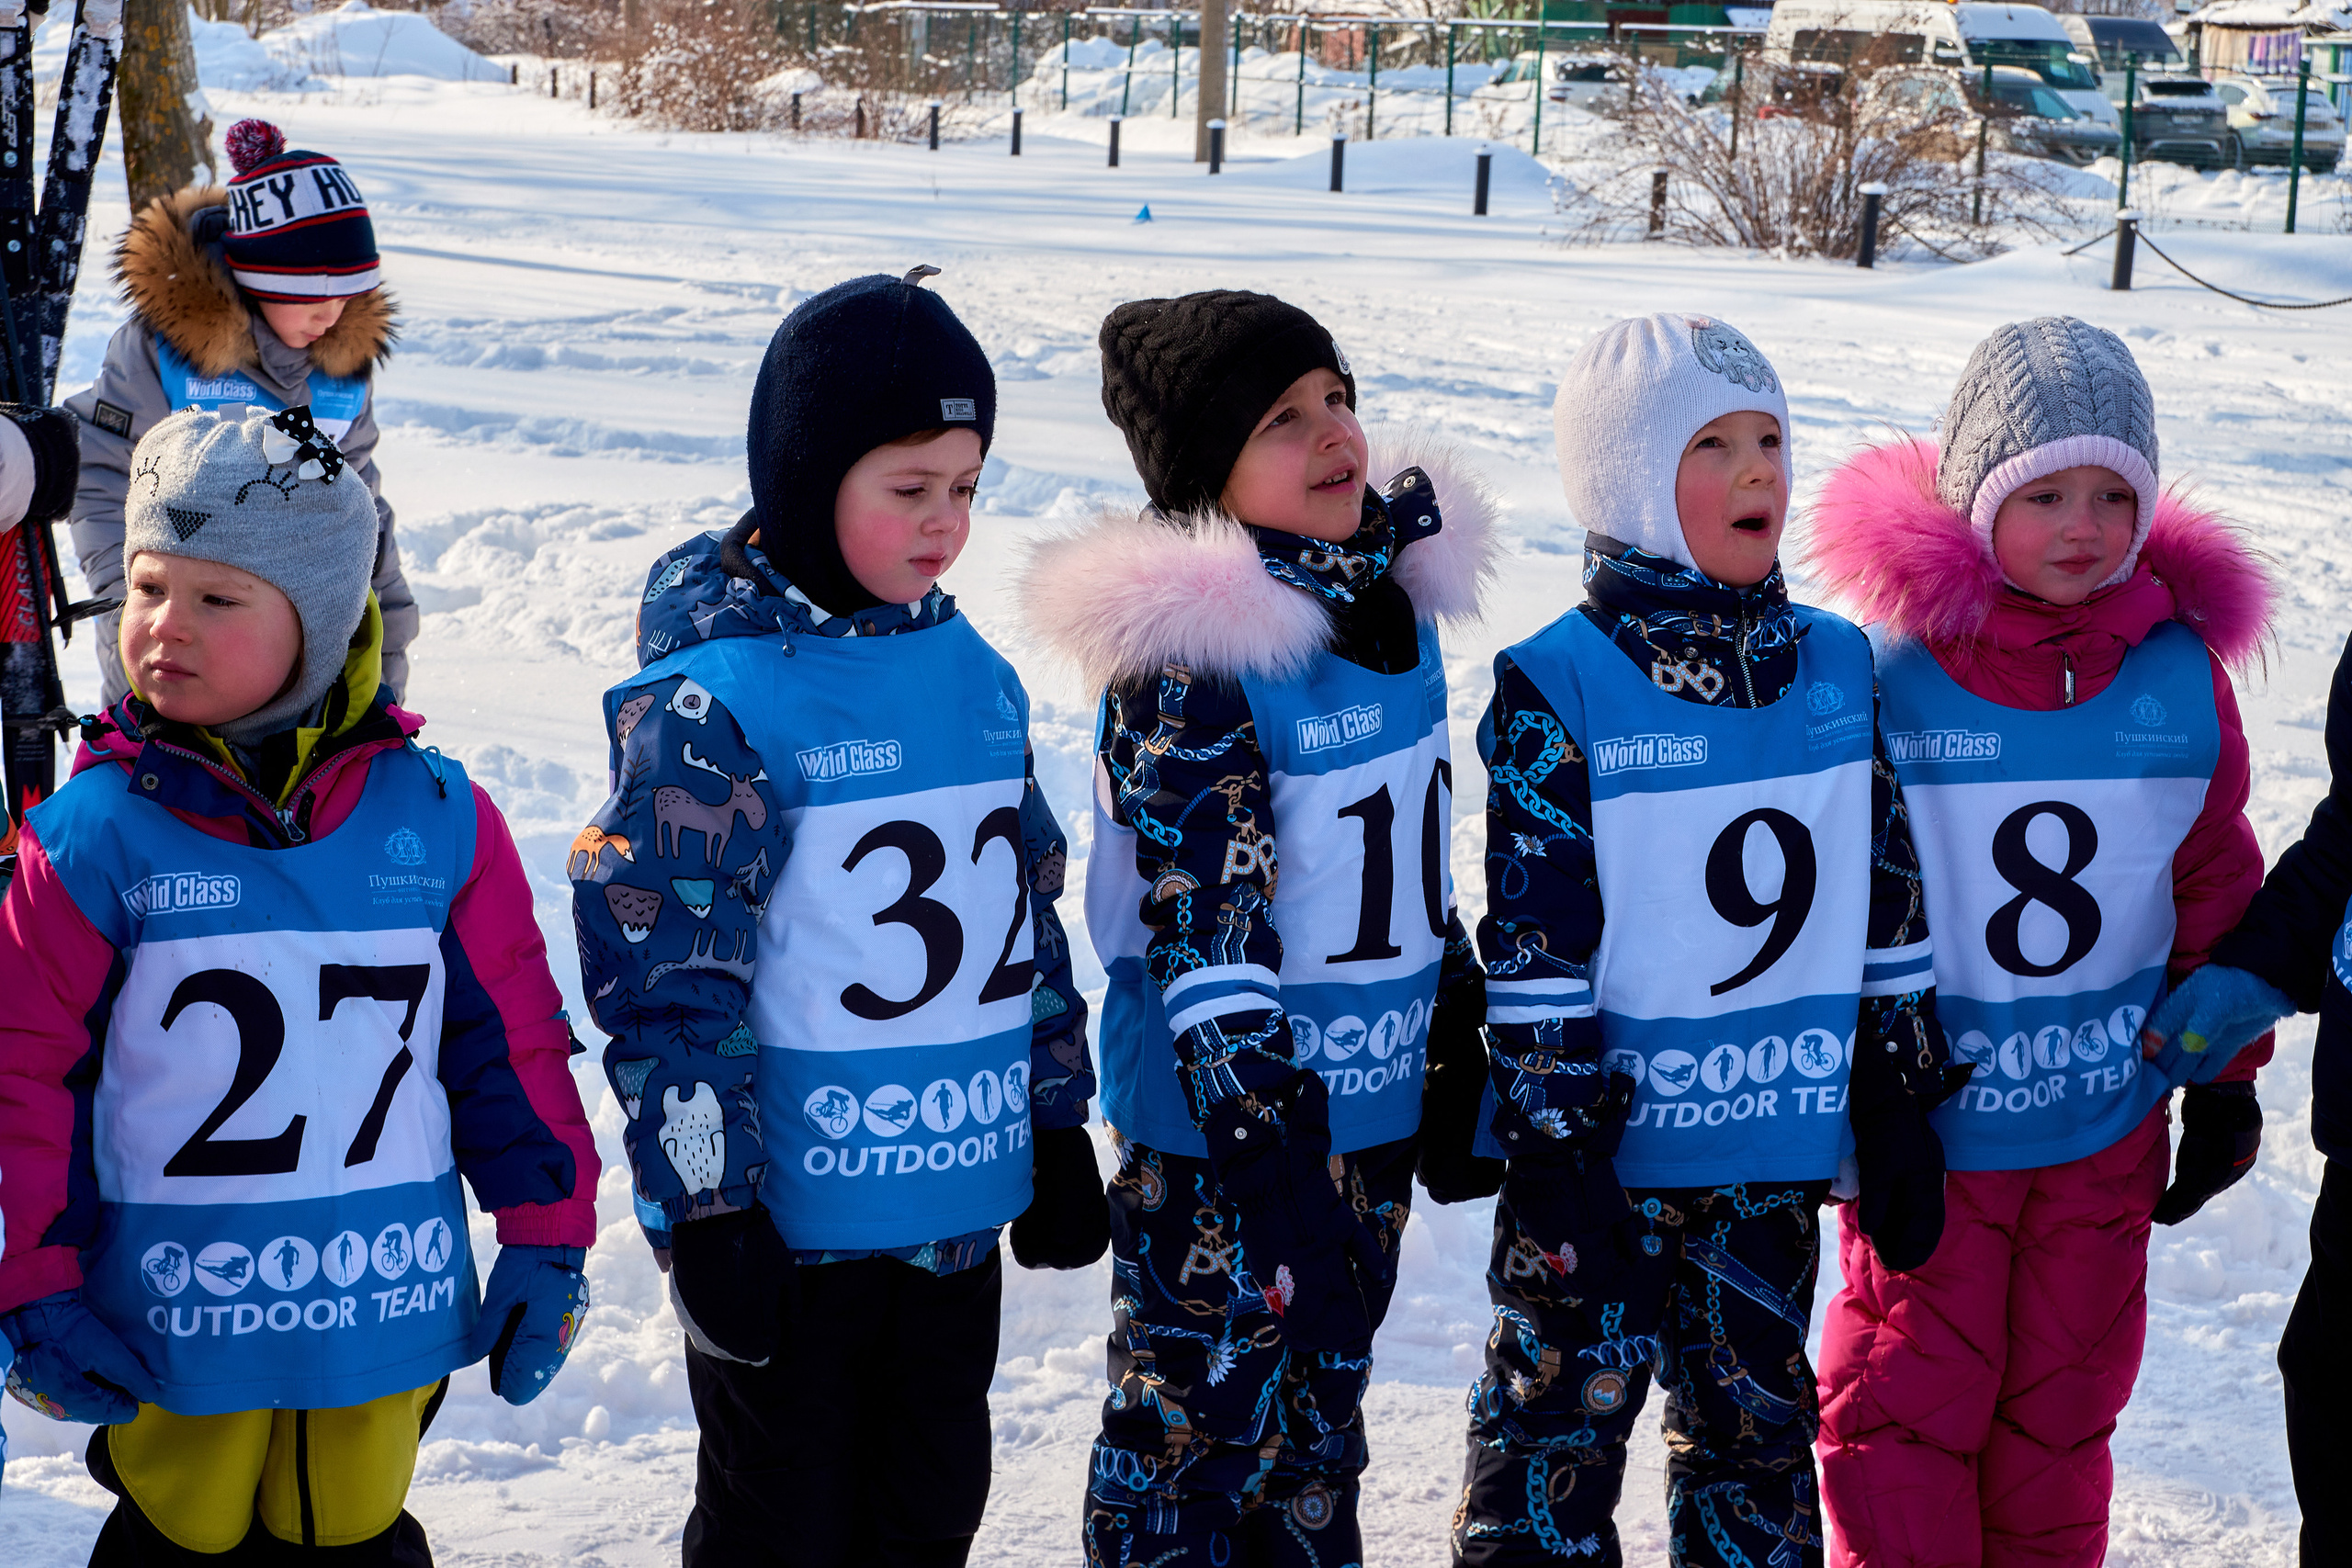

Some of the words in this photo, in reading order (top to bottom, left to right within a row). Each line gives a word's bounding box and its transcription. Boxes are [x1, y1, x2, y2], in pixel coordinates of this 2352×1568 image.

[230, 173, 295, 232] KEY
[188, 381, 221, 398] World
[223, 381, 254, 398] Class
[983, 729, 1023, 744] Пушки
[1341, 707, 1381, 739] Class
[2115, 731, 2189, 745] Пушкинский
[850, 744, 897, 772] Class
[1597, 737, 1654, 772] World
[1657, 736, 1703, 764] Class
[1891, 734, 1939, 761] World
[1944, 733, 1997, 759] Class
[1325, 756, 1452, 964] 10
[129, 879, 170, 915] Wrld
[175, 876, 236, 907] Class
[368, 874, 446, 890] Пушкиский
[1704, 807, 1817, 998] 9
[1984, 800, 2102, 978] 8
[840, 806, 1034, 1021] 32
[160, 963, 431, 1178] 27
[1317, 1053, 1413, 1096] TDOOR
[1940, 1074, 2067, 1113] TDOOR
[2080, 1044, 2143, 1096] TEA
[1626, 1089, 1779, 1128] UTDOOR
[803, 1131, 998, 1177] OUTDOOR
[1004, 1113, 1032, 1154] TEA
[147, 1295, 357, 1337] OUTDOOR
[371, 1276, 455, 1323] TEAM
